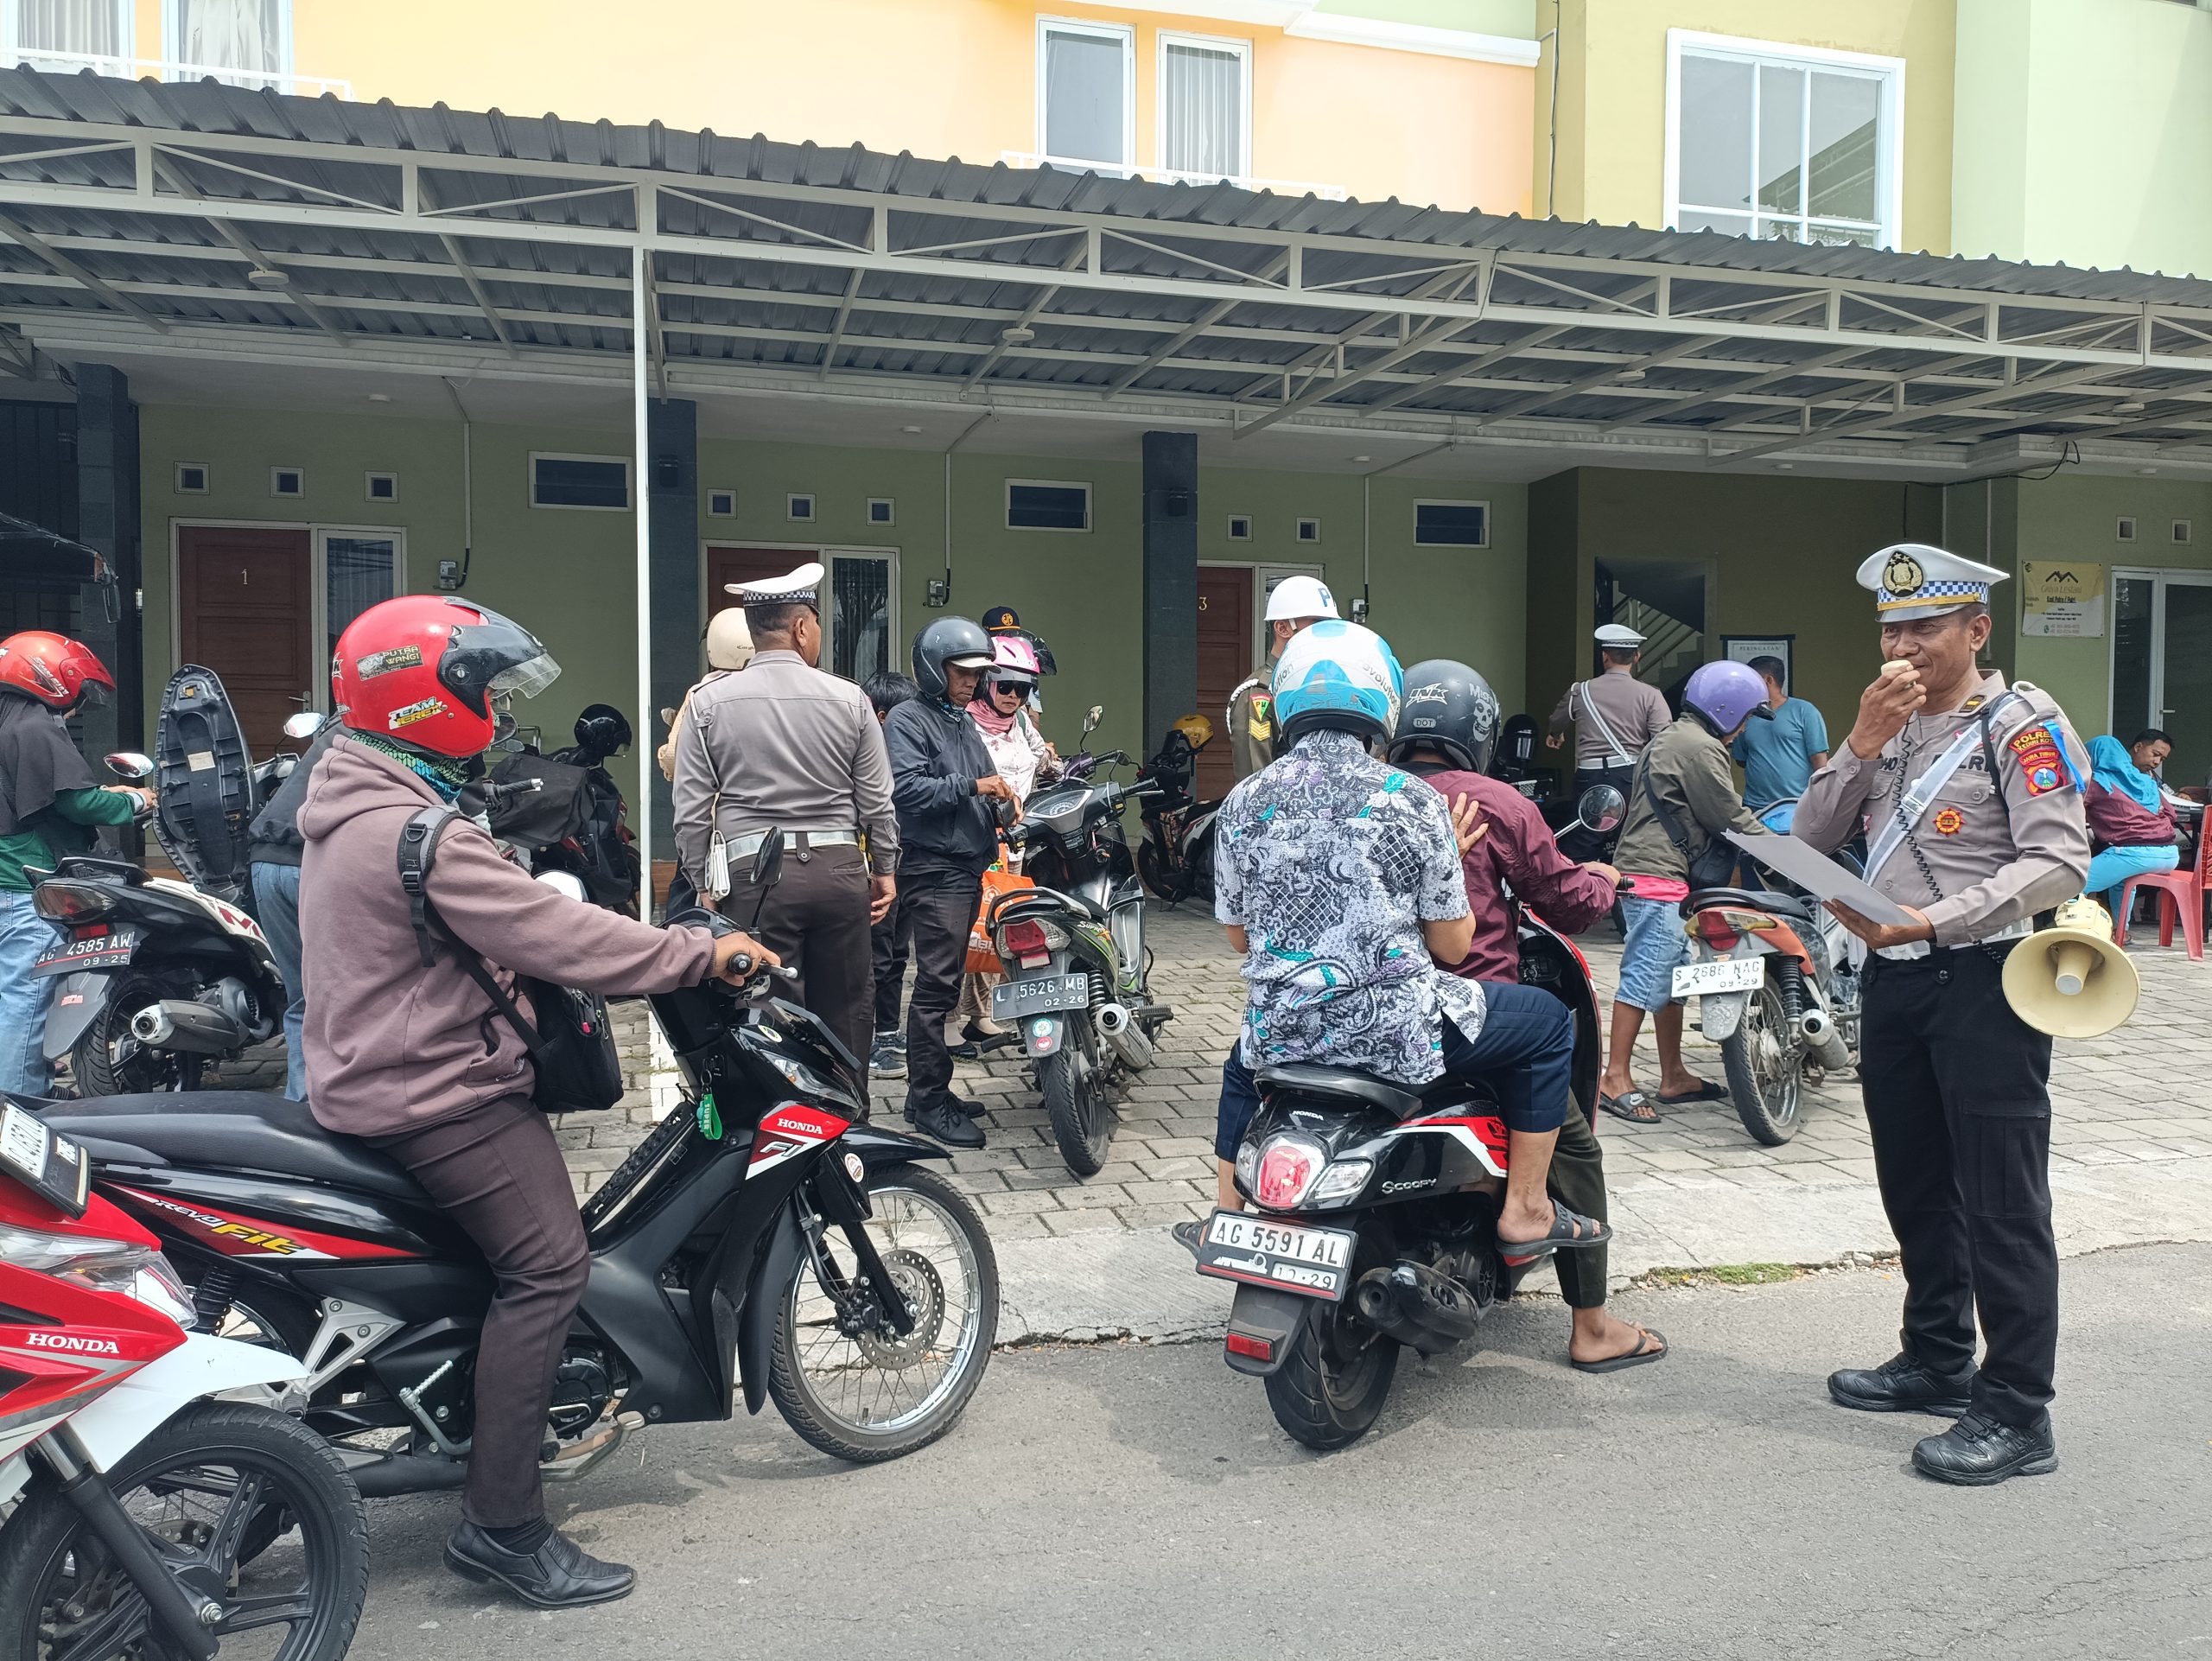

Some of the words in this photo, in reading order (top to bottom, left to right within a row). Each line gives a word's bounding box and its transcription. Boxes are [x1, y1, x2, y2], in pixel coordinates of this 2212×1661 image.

[242, 568, 249, 585] 1
[1198, 596, 1208, 611] 3
[383, 646, 419, 658] PUTRA
[385, 652, 420, 665] WANGI
[1405, 682, 1450, 709] INK
[2013, 731, 2051, 748] POLRE
[67, 937, 105, 957] 4585
[110, 932, 132, 949] AW
[1675, 970, 1682, 981] S
[995, 989, 1006, 1002] L
[1020, 980, 1055, 998] 5626
[1065, 977, 1085, 991] MB
[777, 1117, 823, 1135] HONDA
[1216, 1222, 1243, 1244] AG
[1251, 1226, 1305, 1257] 5591
[1312, 1238, 1338, 1265] AL
[25, 1332, 120, 1354] HONDA
